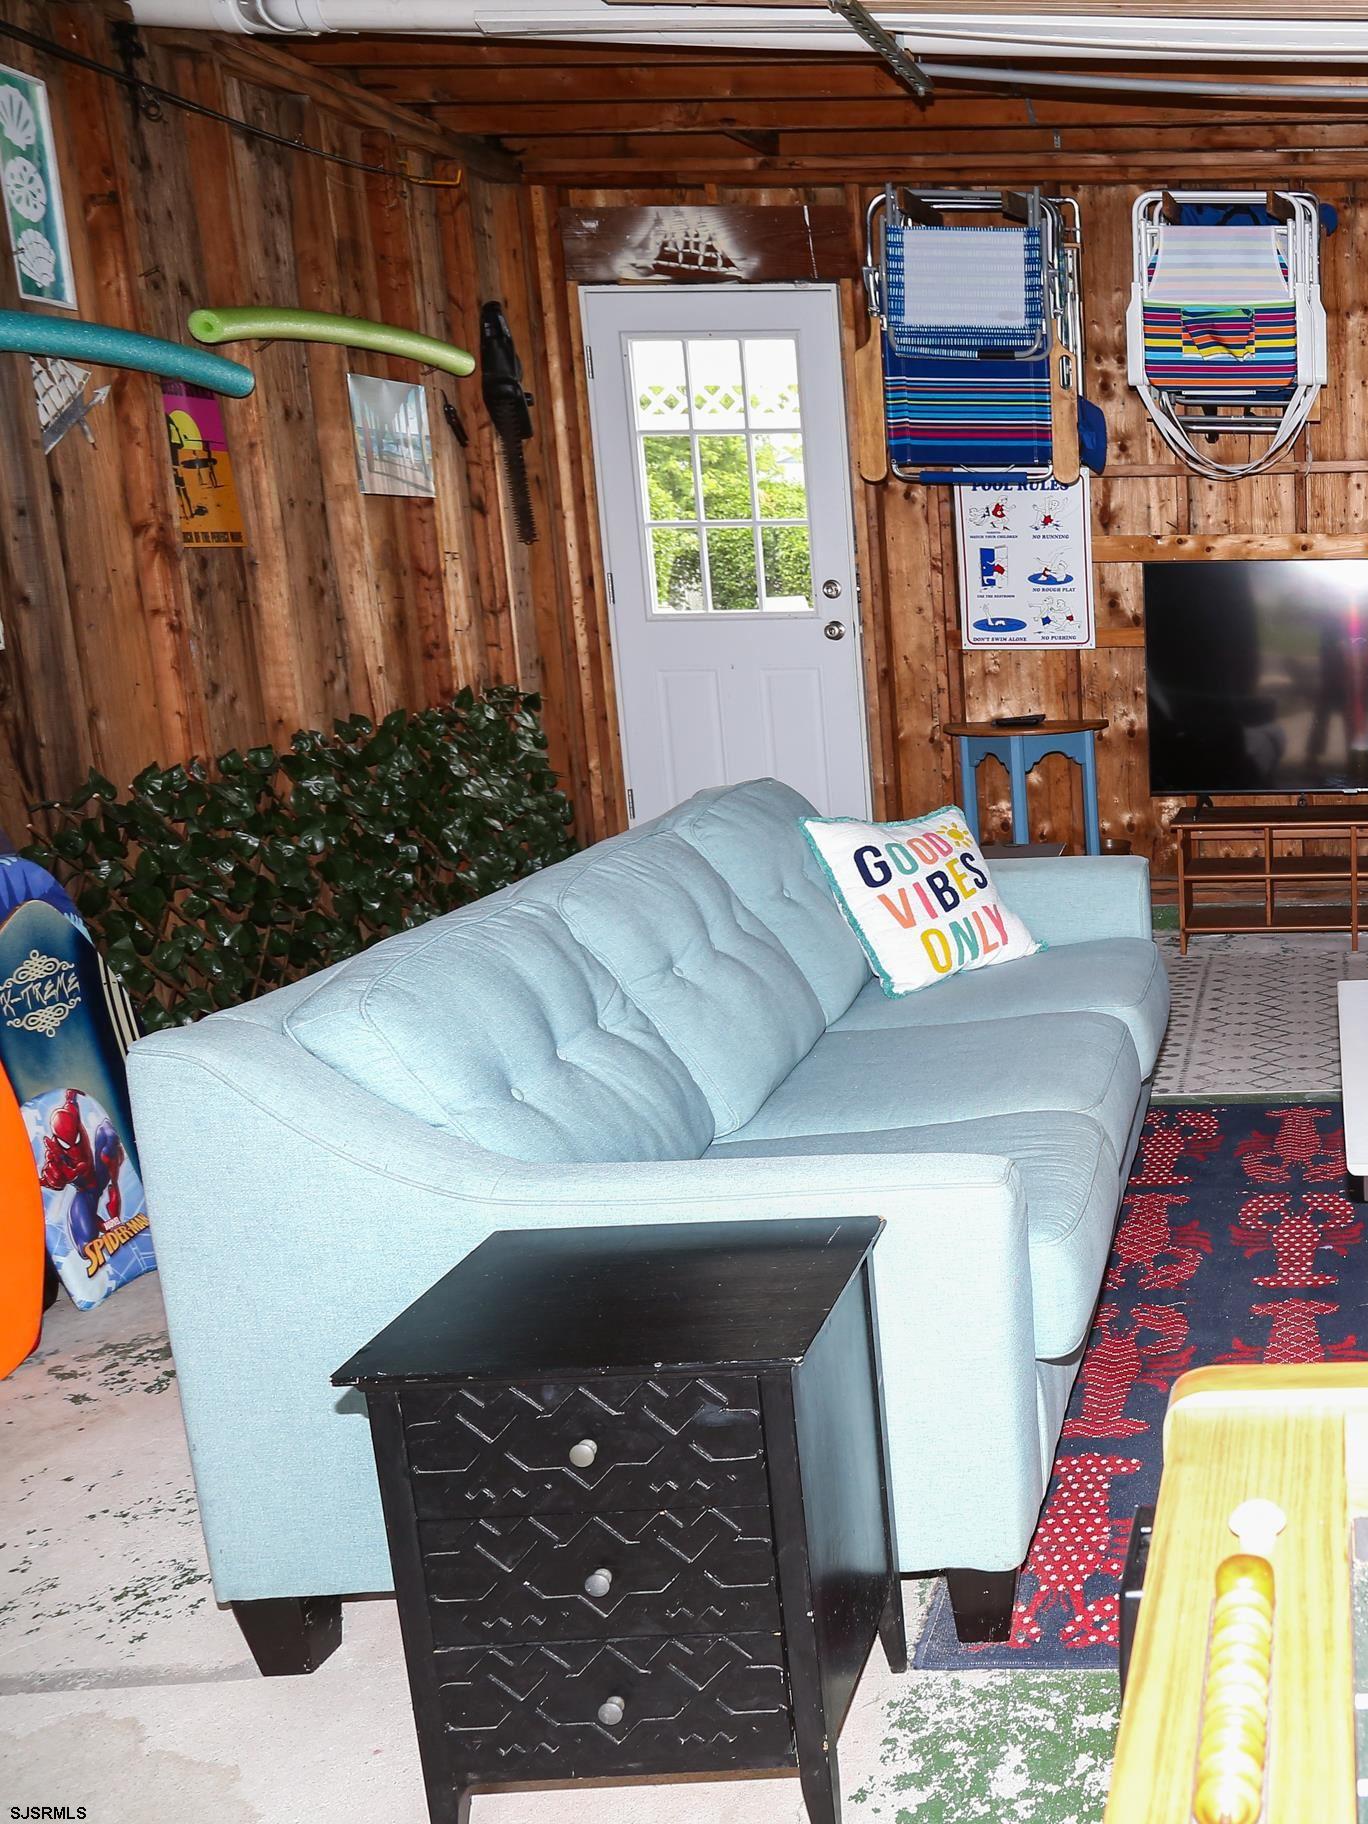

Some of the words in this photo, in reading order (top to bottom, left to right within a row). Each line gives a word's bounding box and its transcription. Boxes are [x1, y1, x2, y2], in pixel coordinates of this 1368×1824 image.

[971, 483, 1013, 492] POOL
[1018, 480, 1069, 492] RULES
[853, 832, 954, 889] GOOD
[877, 852, 988, 929] VIBES
[920, 904, 1009, 974] ONLY
[0, 972, 80, 1017] X-TREME
